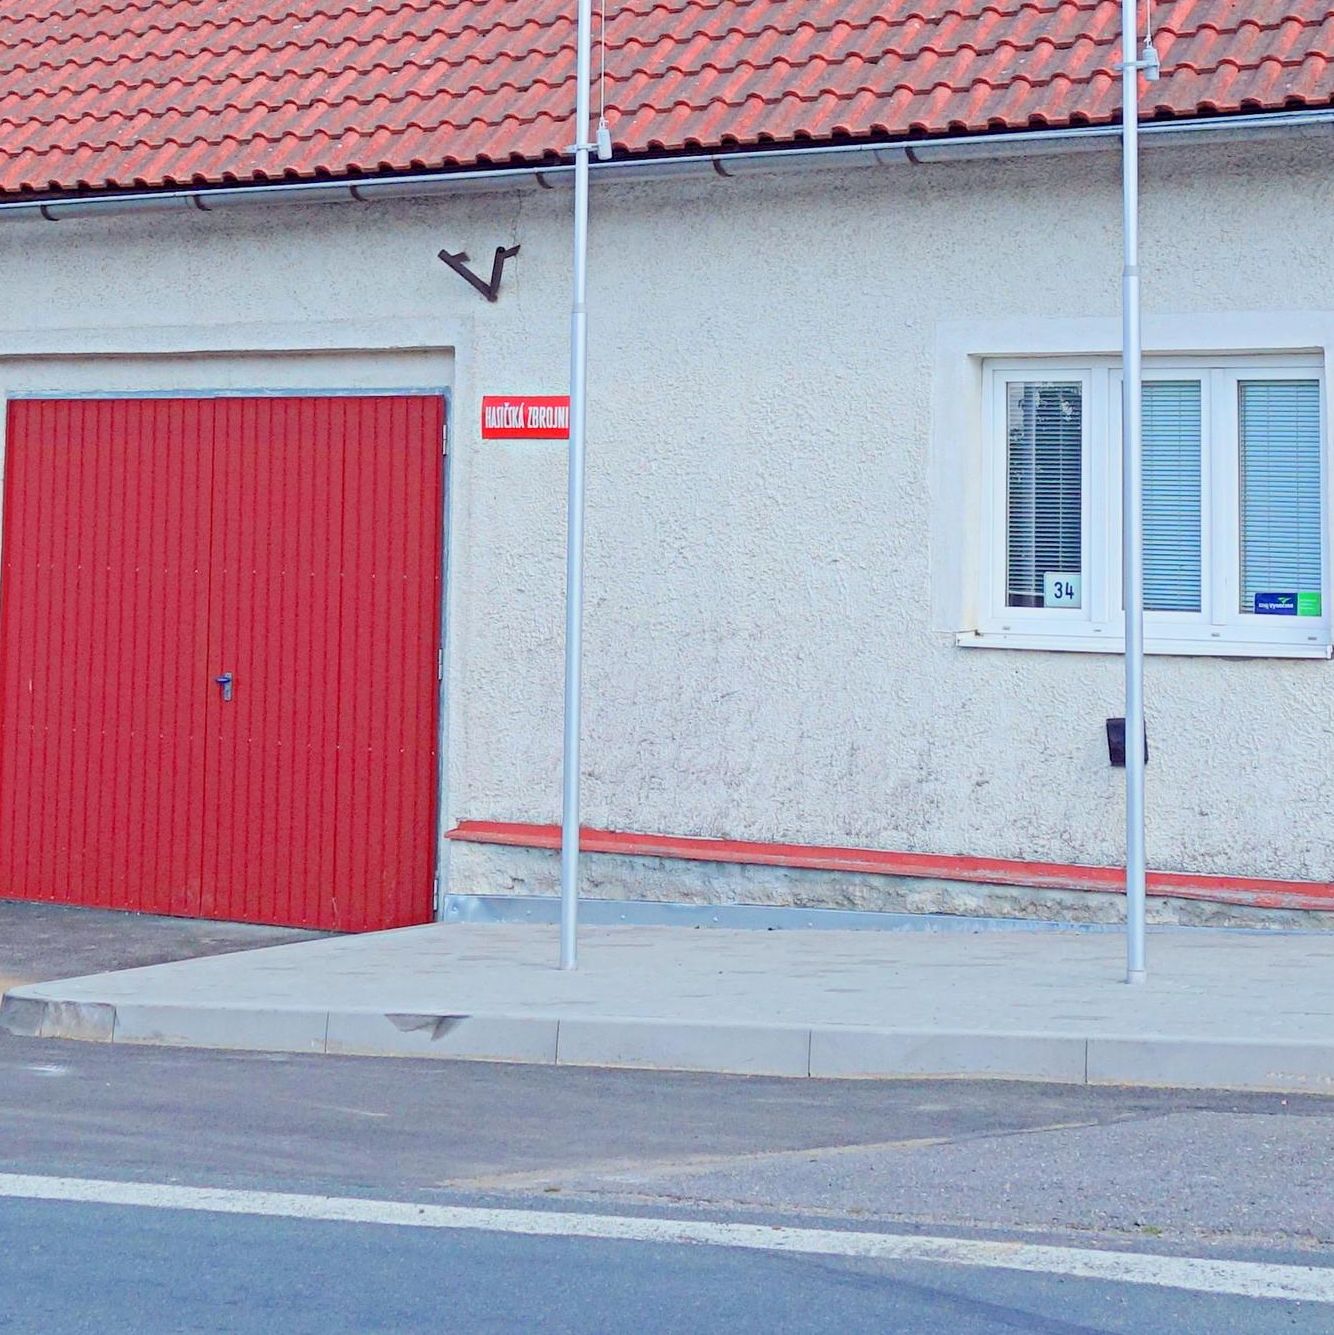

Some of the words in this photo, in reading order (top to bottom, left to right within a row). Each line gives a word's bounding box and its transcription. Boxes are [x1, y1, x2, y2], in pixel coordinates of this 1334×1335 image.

[484, 402, 525, 429] HASIČSKÁ
[526, 405, 569, 429] ZBROJNI
[1054, 581, 1075, 600] 34
